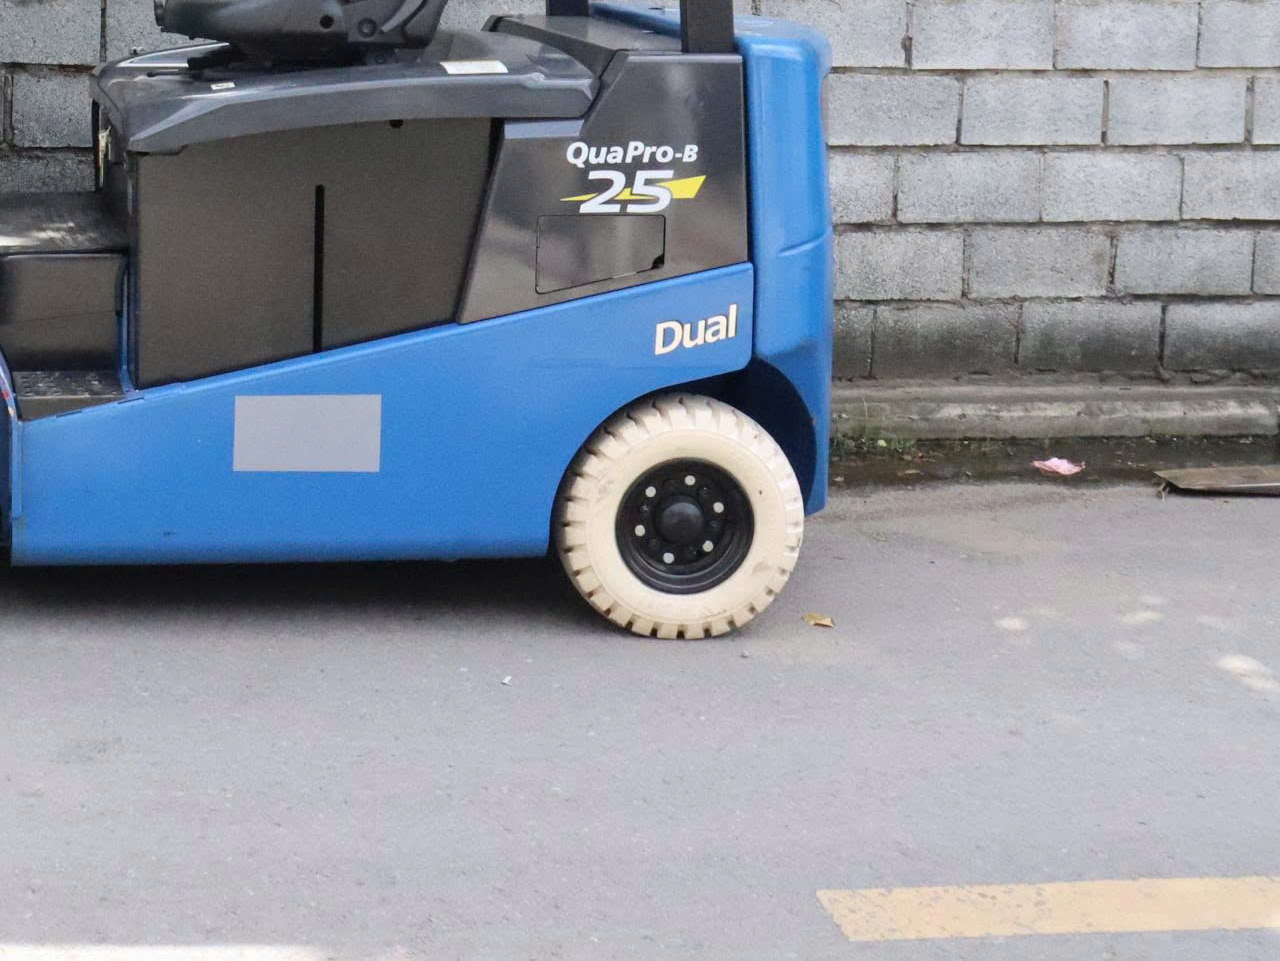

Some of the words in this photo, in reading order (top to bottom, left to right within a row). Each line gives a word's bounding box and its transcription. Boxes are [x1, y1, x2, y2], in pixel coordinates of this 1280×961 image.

[566, 140, 699, 166] QuaPro-B
[579, 169, 674, 214] 25
[654, 303, 738, 356] Dual
